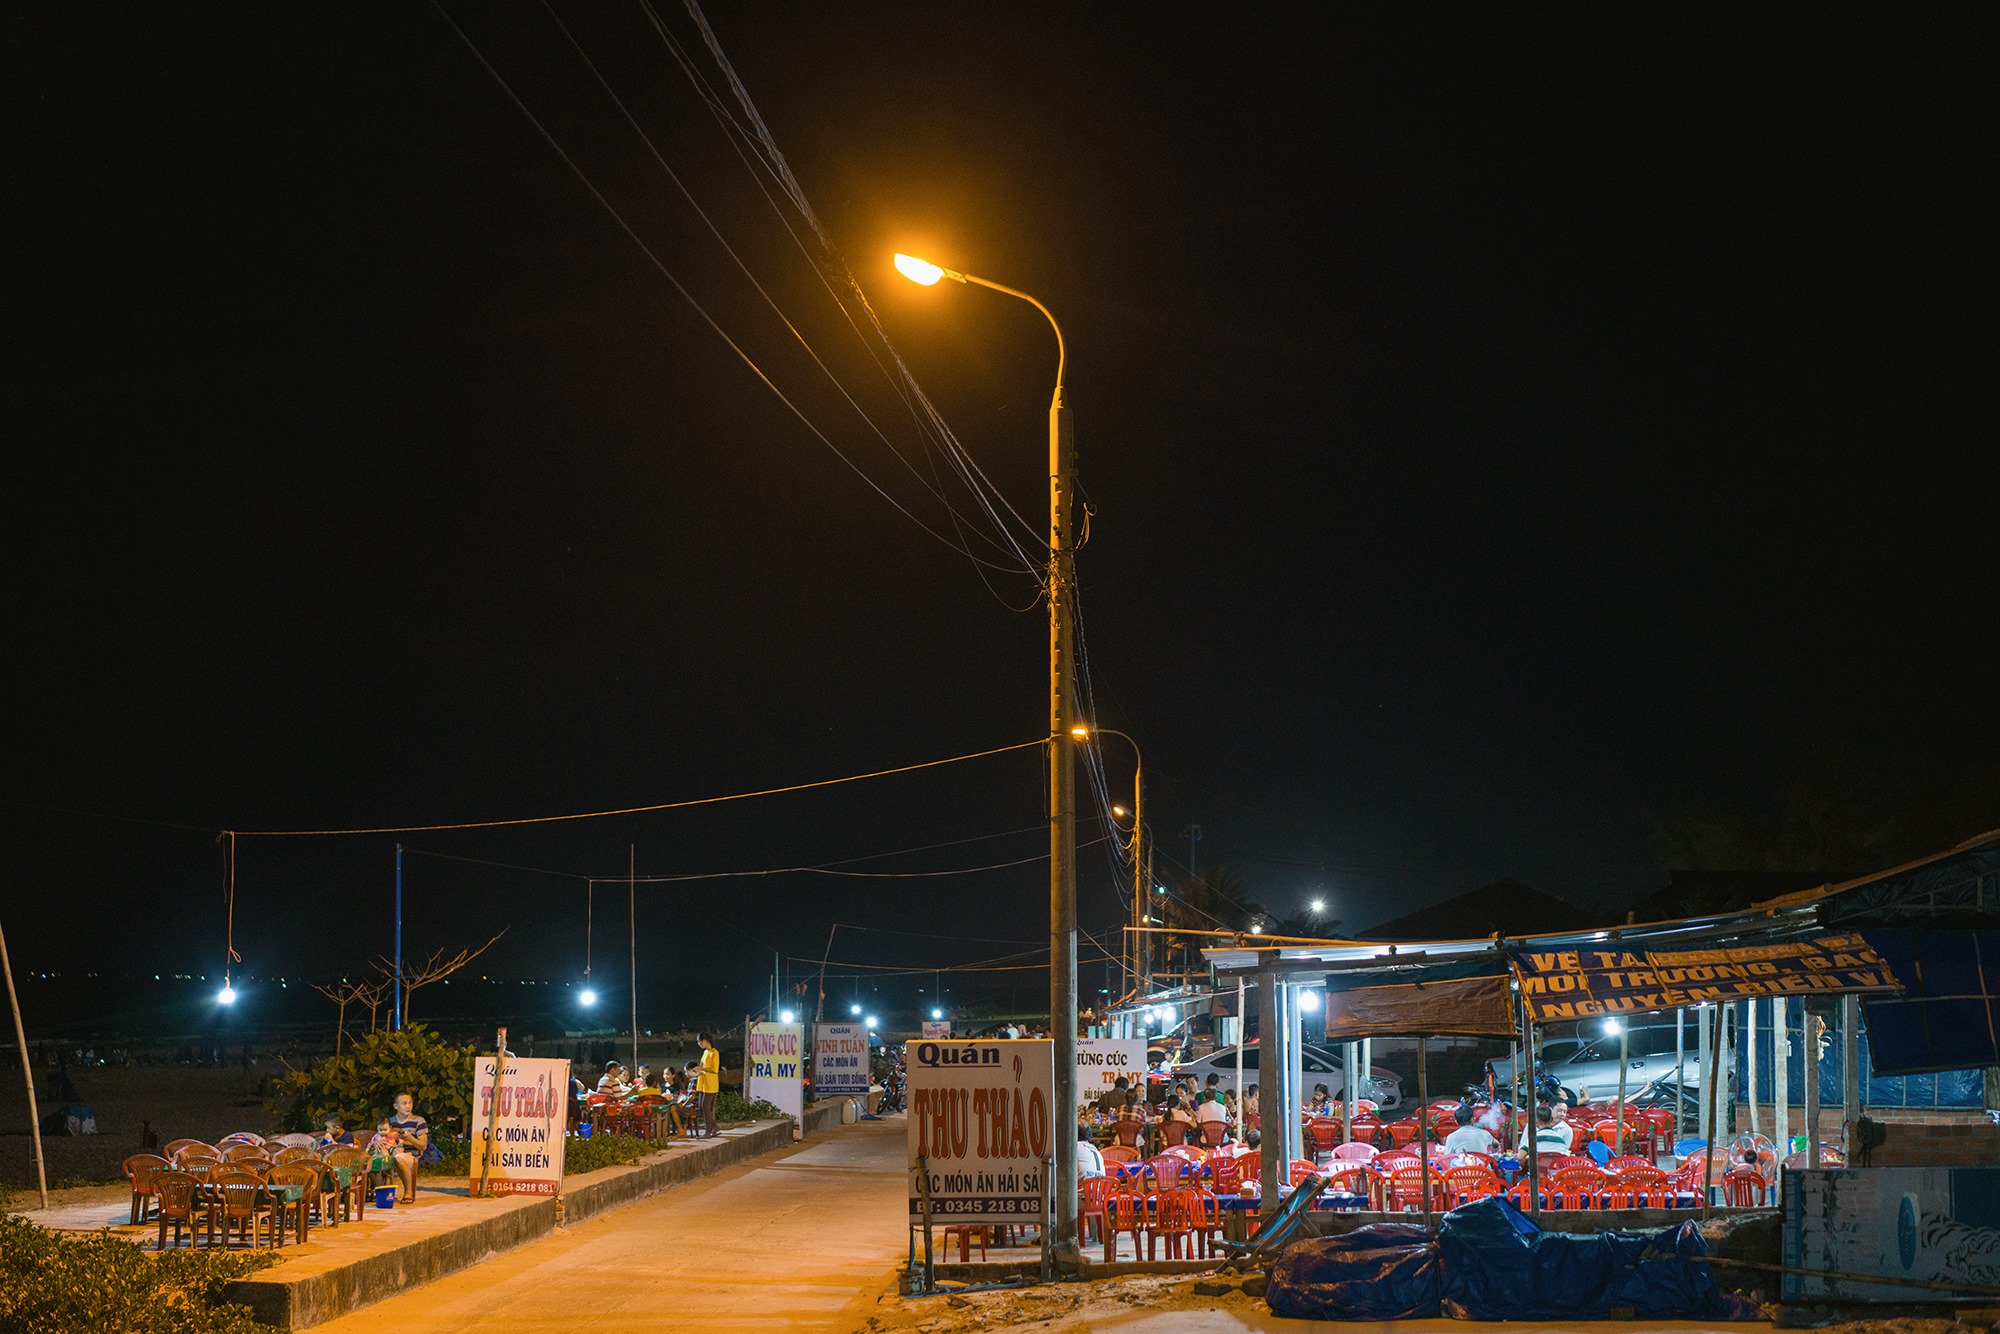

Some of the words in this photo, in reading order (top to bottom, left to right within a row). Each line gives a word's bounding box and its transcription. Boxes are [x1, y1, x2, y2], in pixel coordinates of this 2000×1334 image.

[918, 1043, 1000, 1067] Quán
[1106, 1050, 1128, 1066] CÚC
[777, 1063, 797, 1078] MY
[1126, 1071, 1143, 1084] MY
[515, 1073, 559, 1119] THẢO
[914, 1086, 969, 1160] THU
[973, 1054, 1048, 1160] THẢO
[482, 1127, 502, 1142] CC
[505, 1124, 528, 1143] MÓN
[531, 1126, 545, 1143] ĂN
[502, 1148, 522, 1167] SẢN
[525, 1146, 550, 1169] BIỂN
[493, 1182, 513, 1191] 0164
[515, 1183, 536, 1192] 5218
[538, 1184, 553, 1193] 081
[944, 1169, 973, 1193] MÓN
[976, 1170, 994, 1193] ĂN
[998, 1166, 1019, 1193] HẢI
[1023, 1166, 1042, 1193] SẢ
[945, 1200, 983, 1213] 0345
[988, 1200, 1016, 1213] 218
